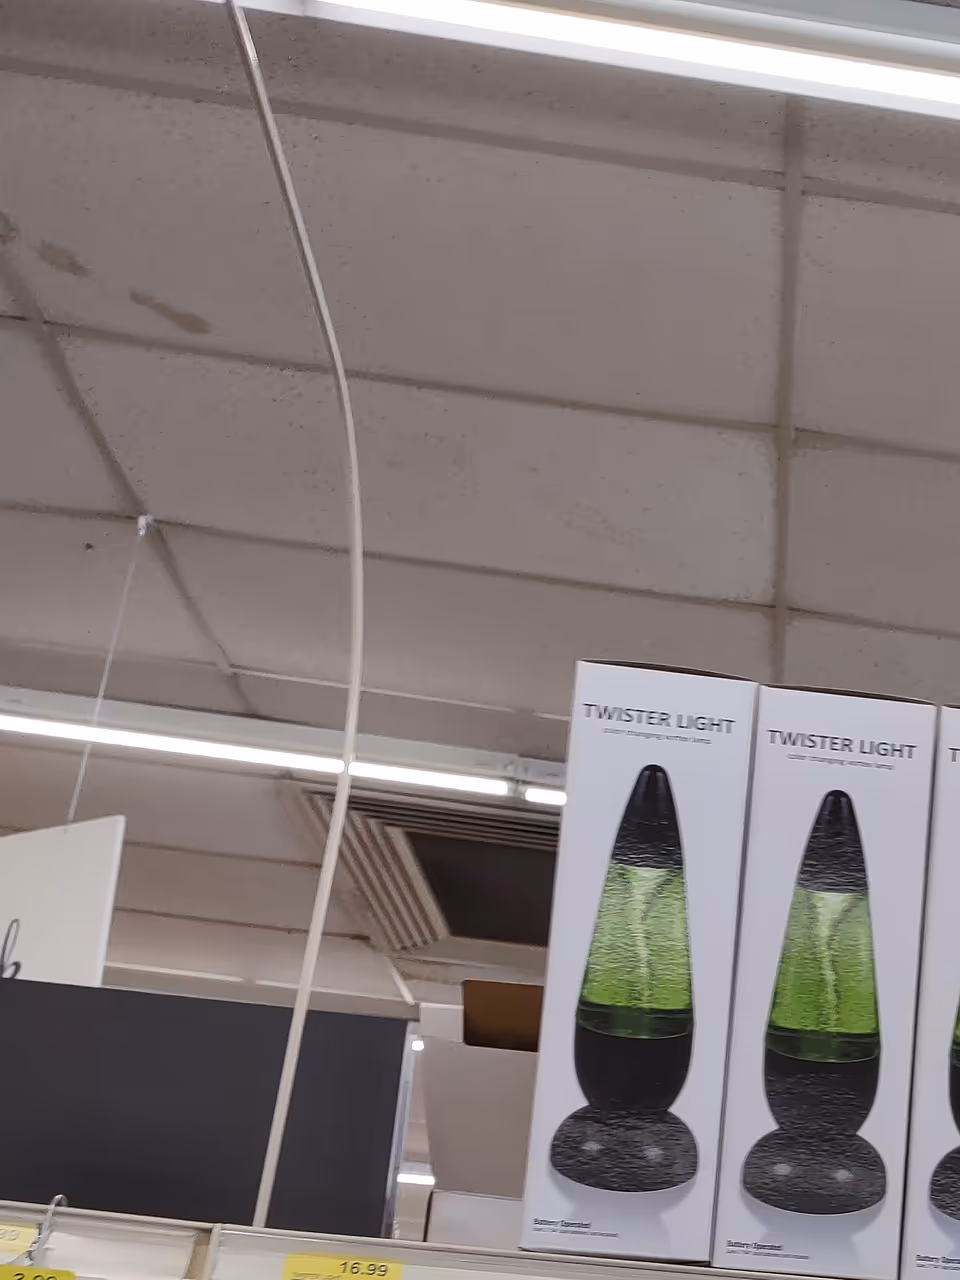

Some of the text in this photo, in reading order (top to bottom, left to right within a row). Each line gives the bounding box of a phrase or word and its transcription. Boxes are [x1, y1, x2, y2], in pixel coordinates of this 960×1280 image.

[582, 703, 736, 734] TWISTER LIGHT
[767, 730, 918, 761] TWISTER LIGHT
[339, 1261, 388, 1278] 16.99
